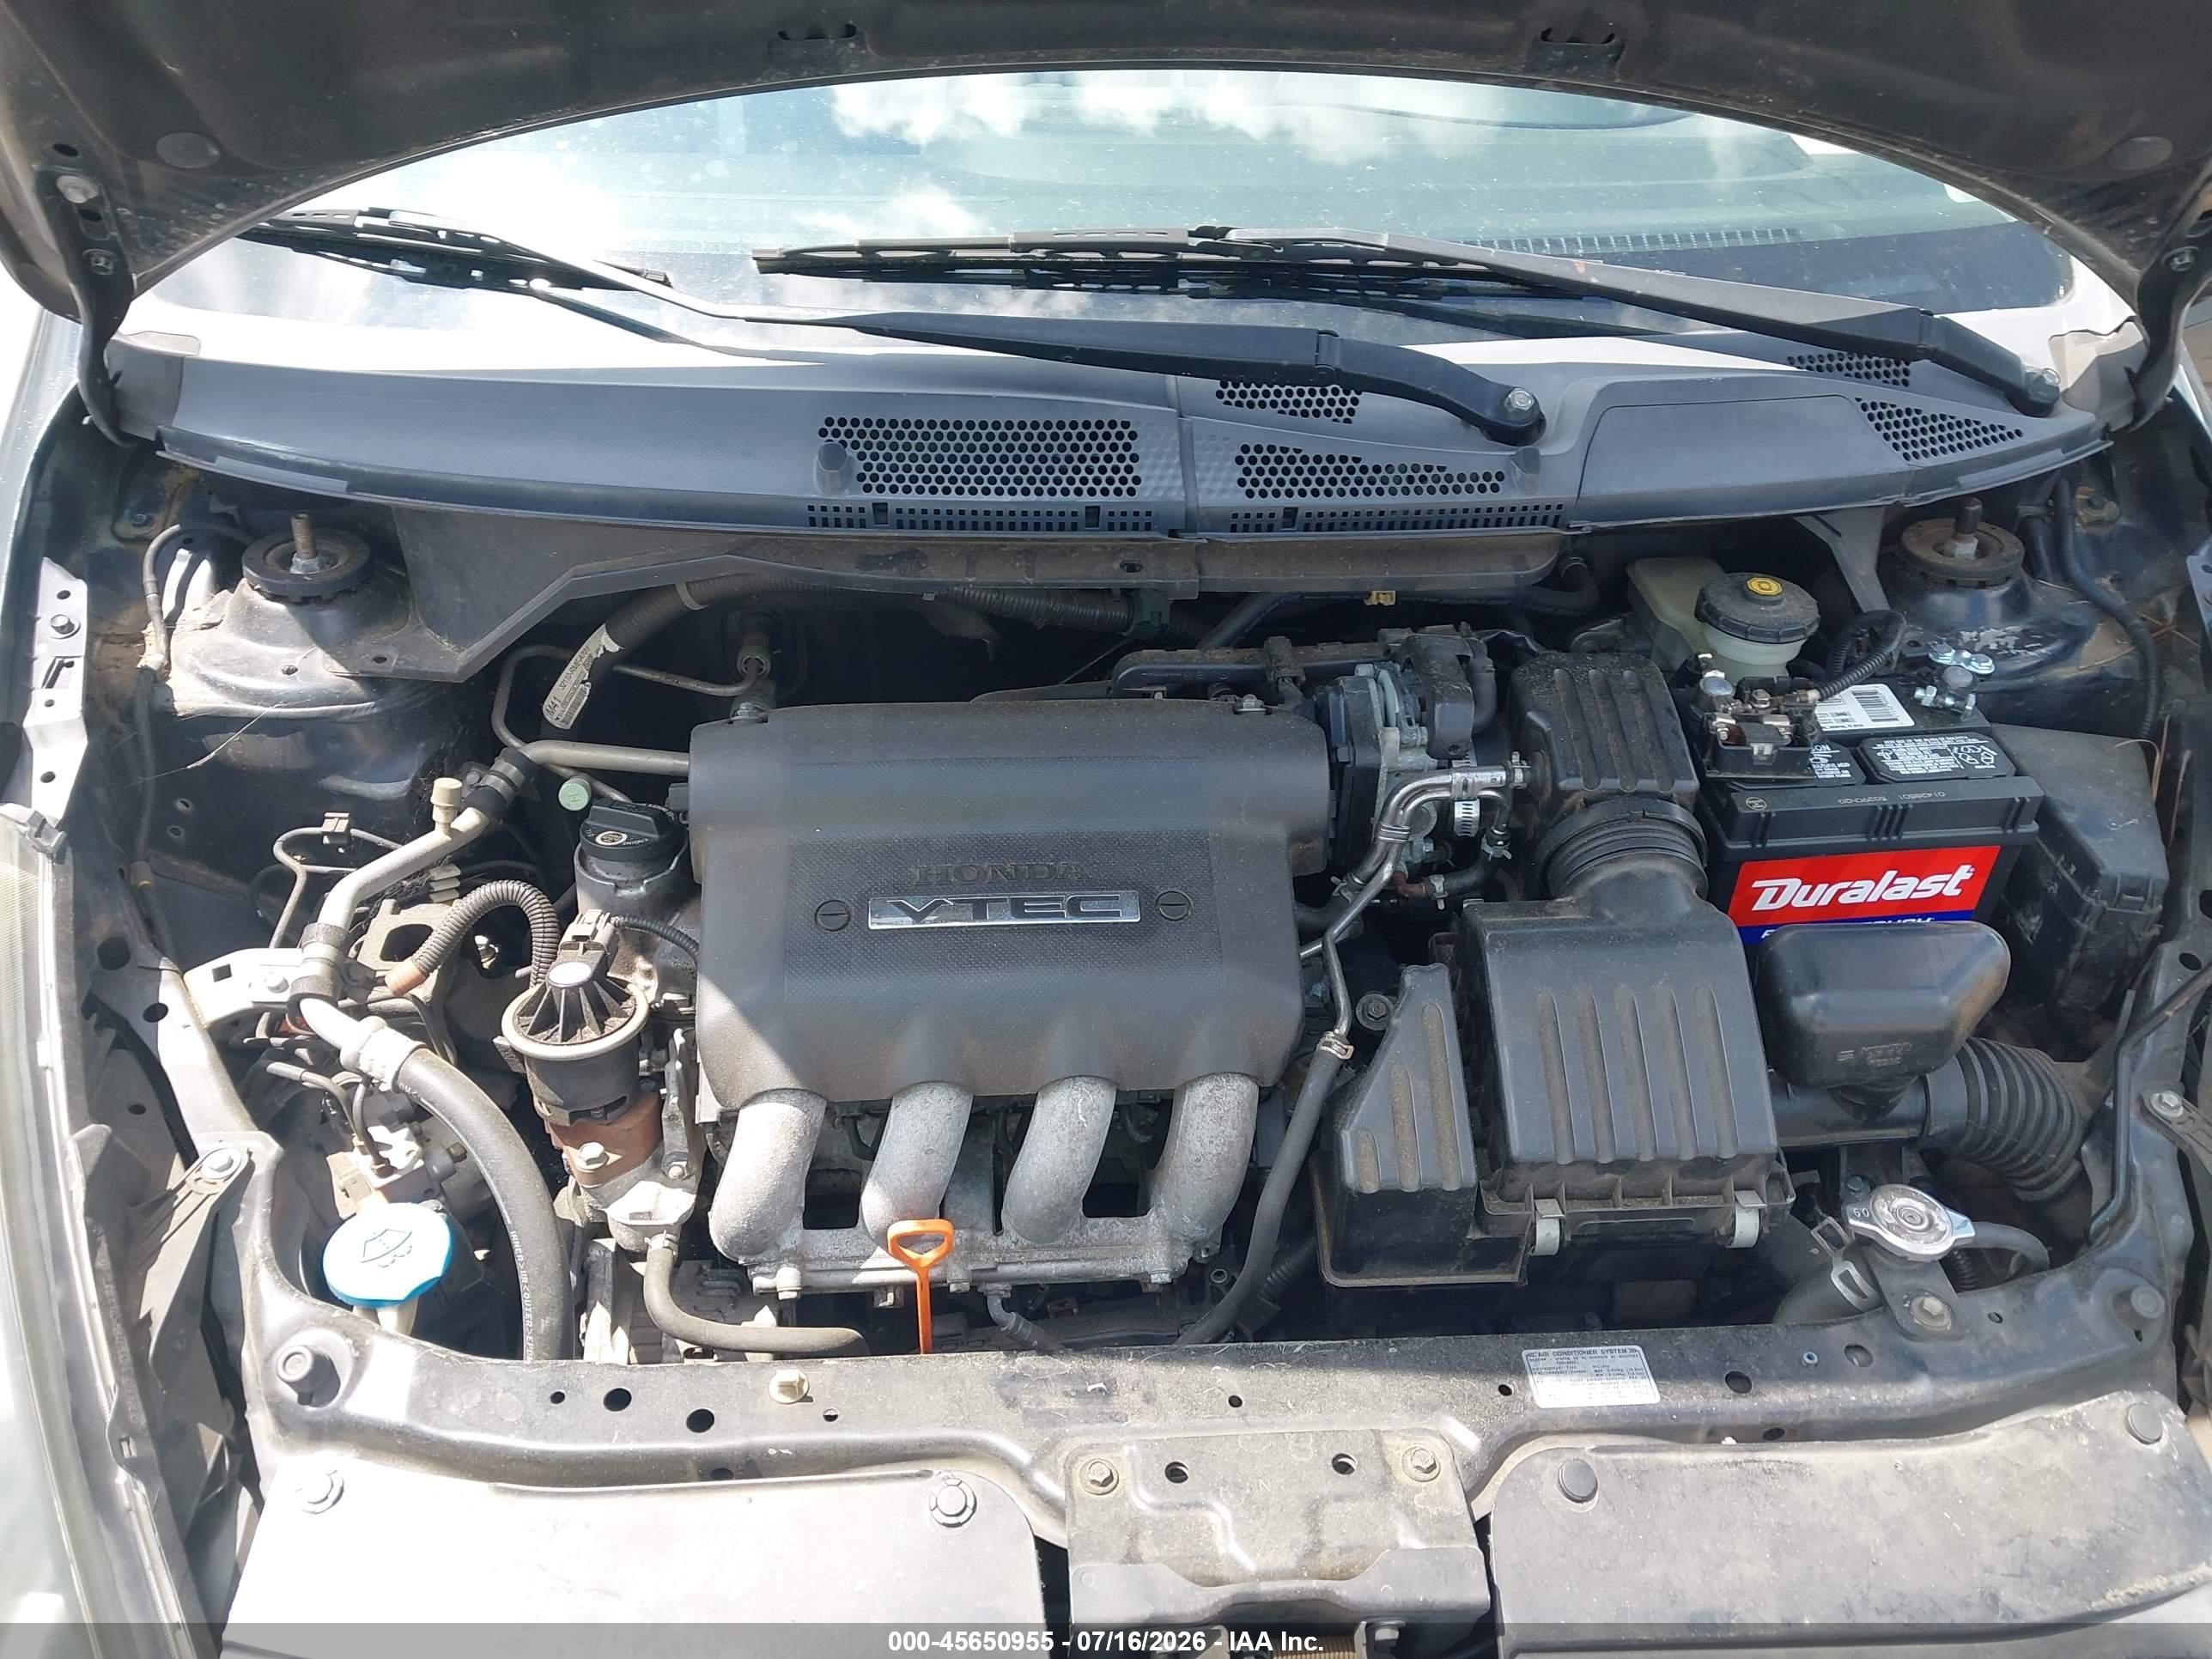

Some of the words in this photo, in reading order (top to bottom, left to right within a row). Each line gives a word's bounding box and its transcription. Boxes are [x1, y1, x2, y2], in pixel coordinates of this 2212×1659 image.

[915, 862, 1093, 885] HONDA
[1752, 864, 1974, 911] Duralast
[886, 894, 1121, 924] VTEC
